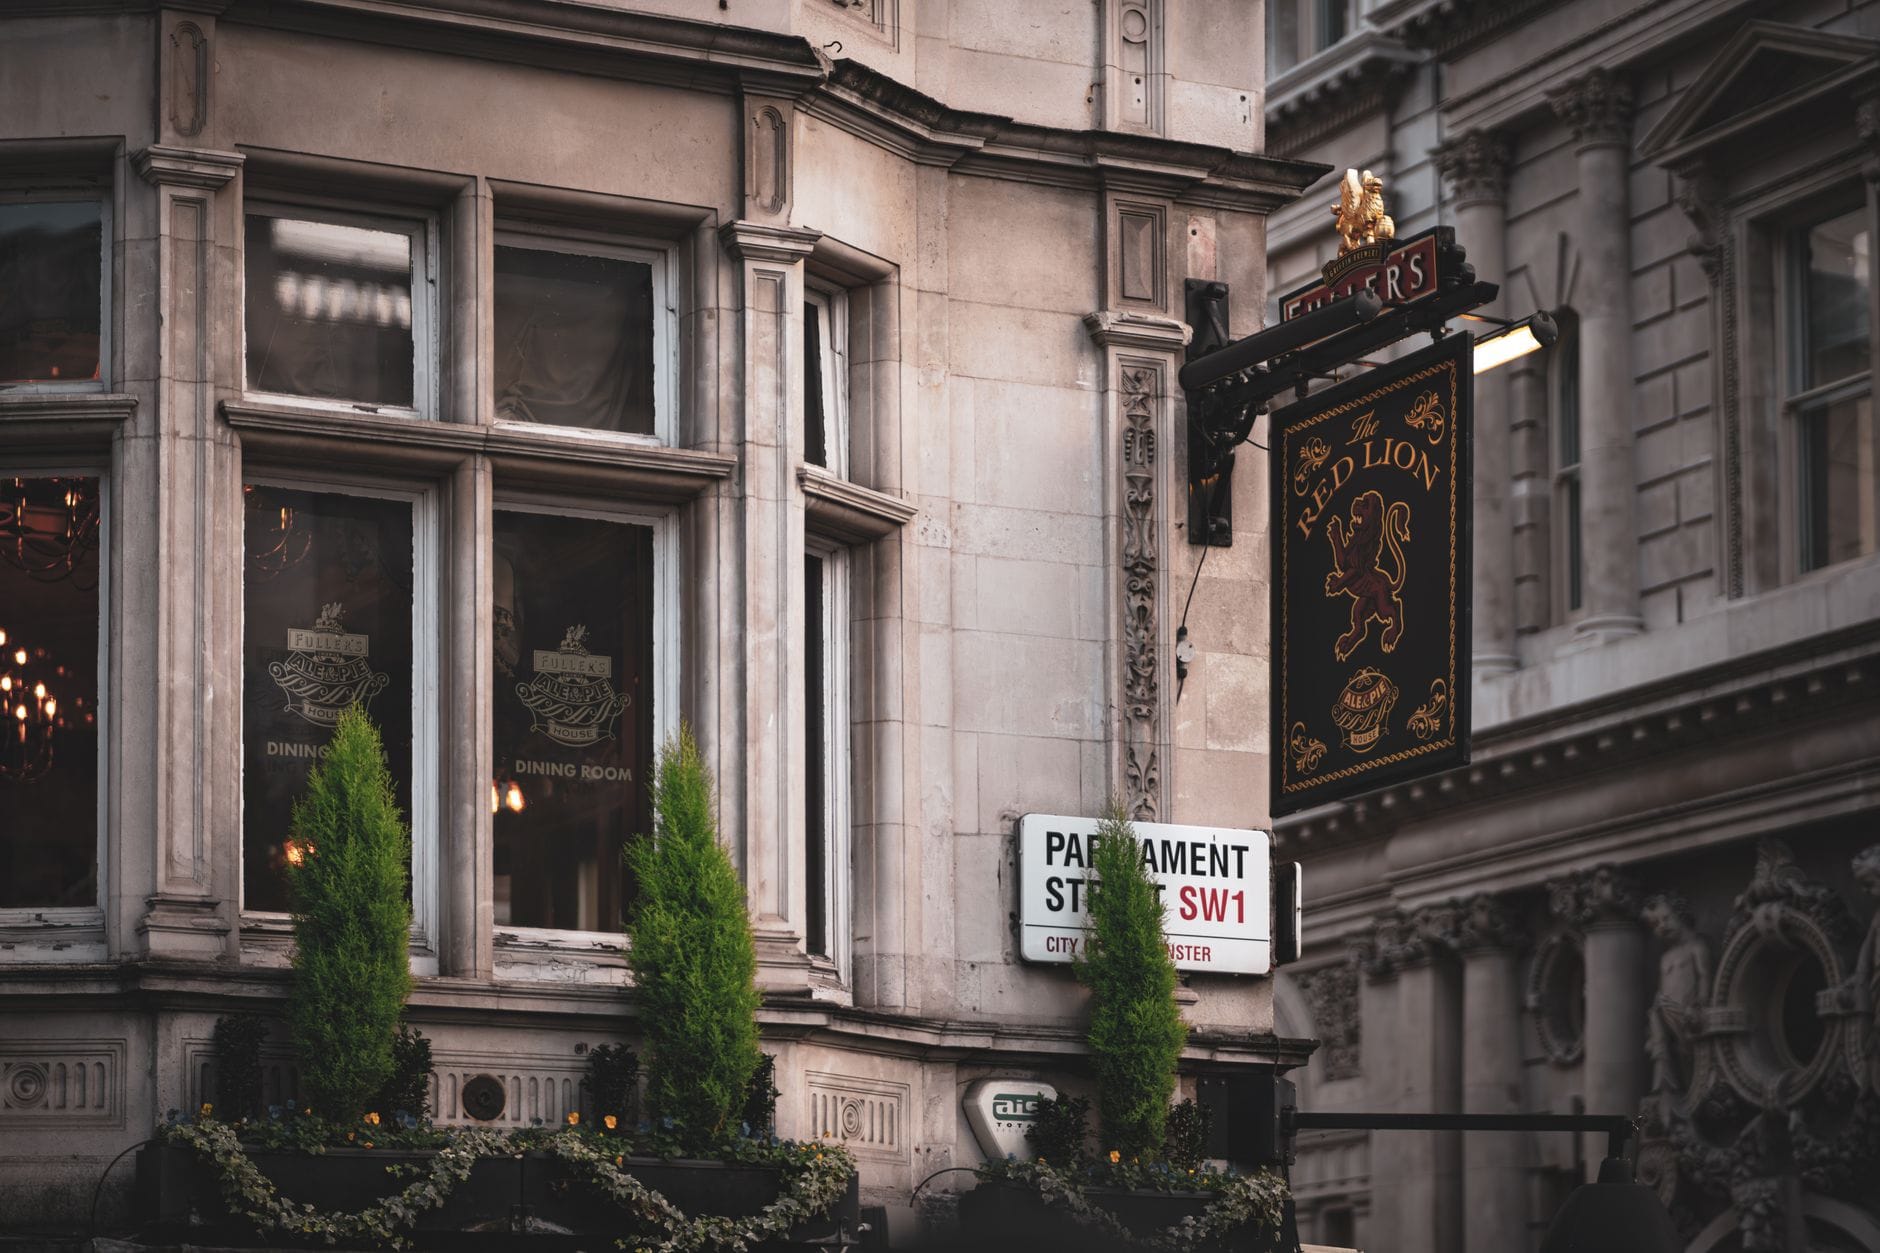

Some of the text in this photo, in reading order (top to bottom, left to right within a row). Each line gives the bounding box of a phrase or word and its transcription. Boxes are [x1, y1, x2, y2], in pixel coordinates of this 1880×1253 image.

[1345, 409, 1380, 446] The
[1297, 438, 1440, 541] RED LION
[296, 633, 362, 652] FULLER'S
[542, 656, 605, 673] FULLER'S
[308, 707, 341, 718] HOUS
[553, 727, 593, 738] HOUSE
[1352, 730, 1377, 743] HOUSE
[515, 760, 632, 781] DINING ROOM
[1179, 886, 1245, 923] SW1
[1046, 936, 1078, 953] CITY
